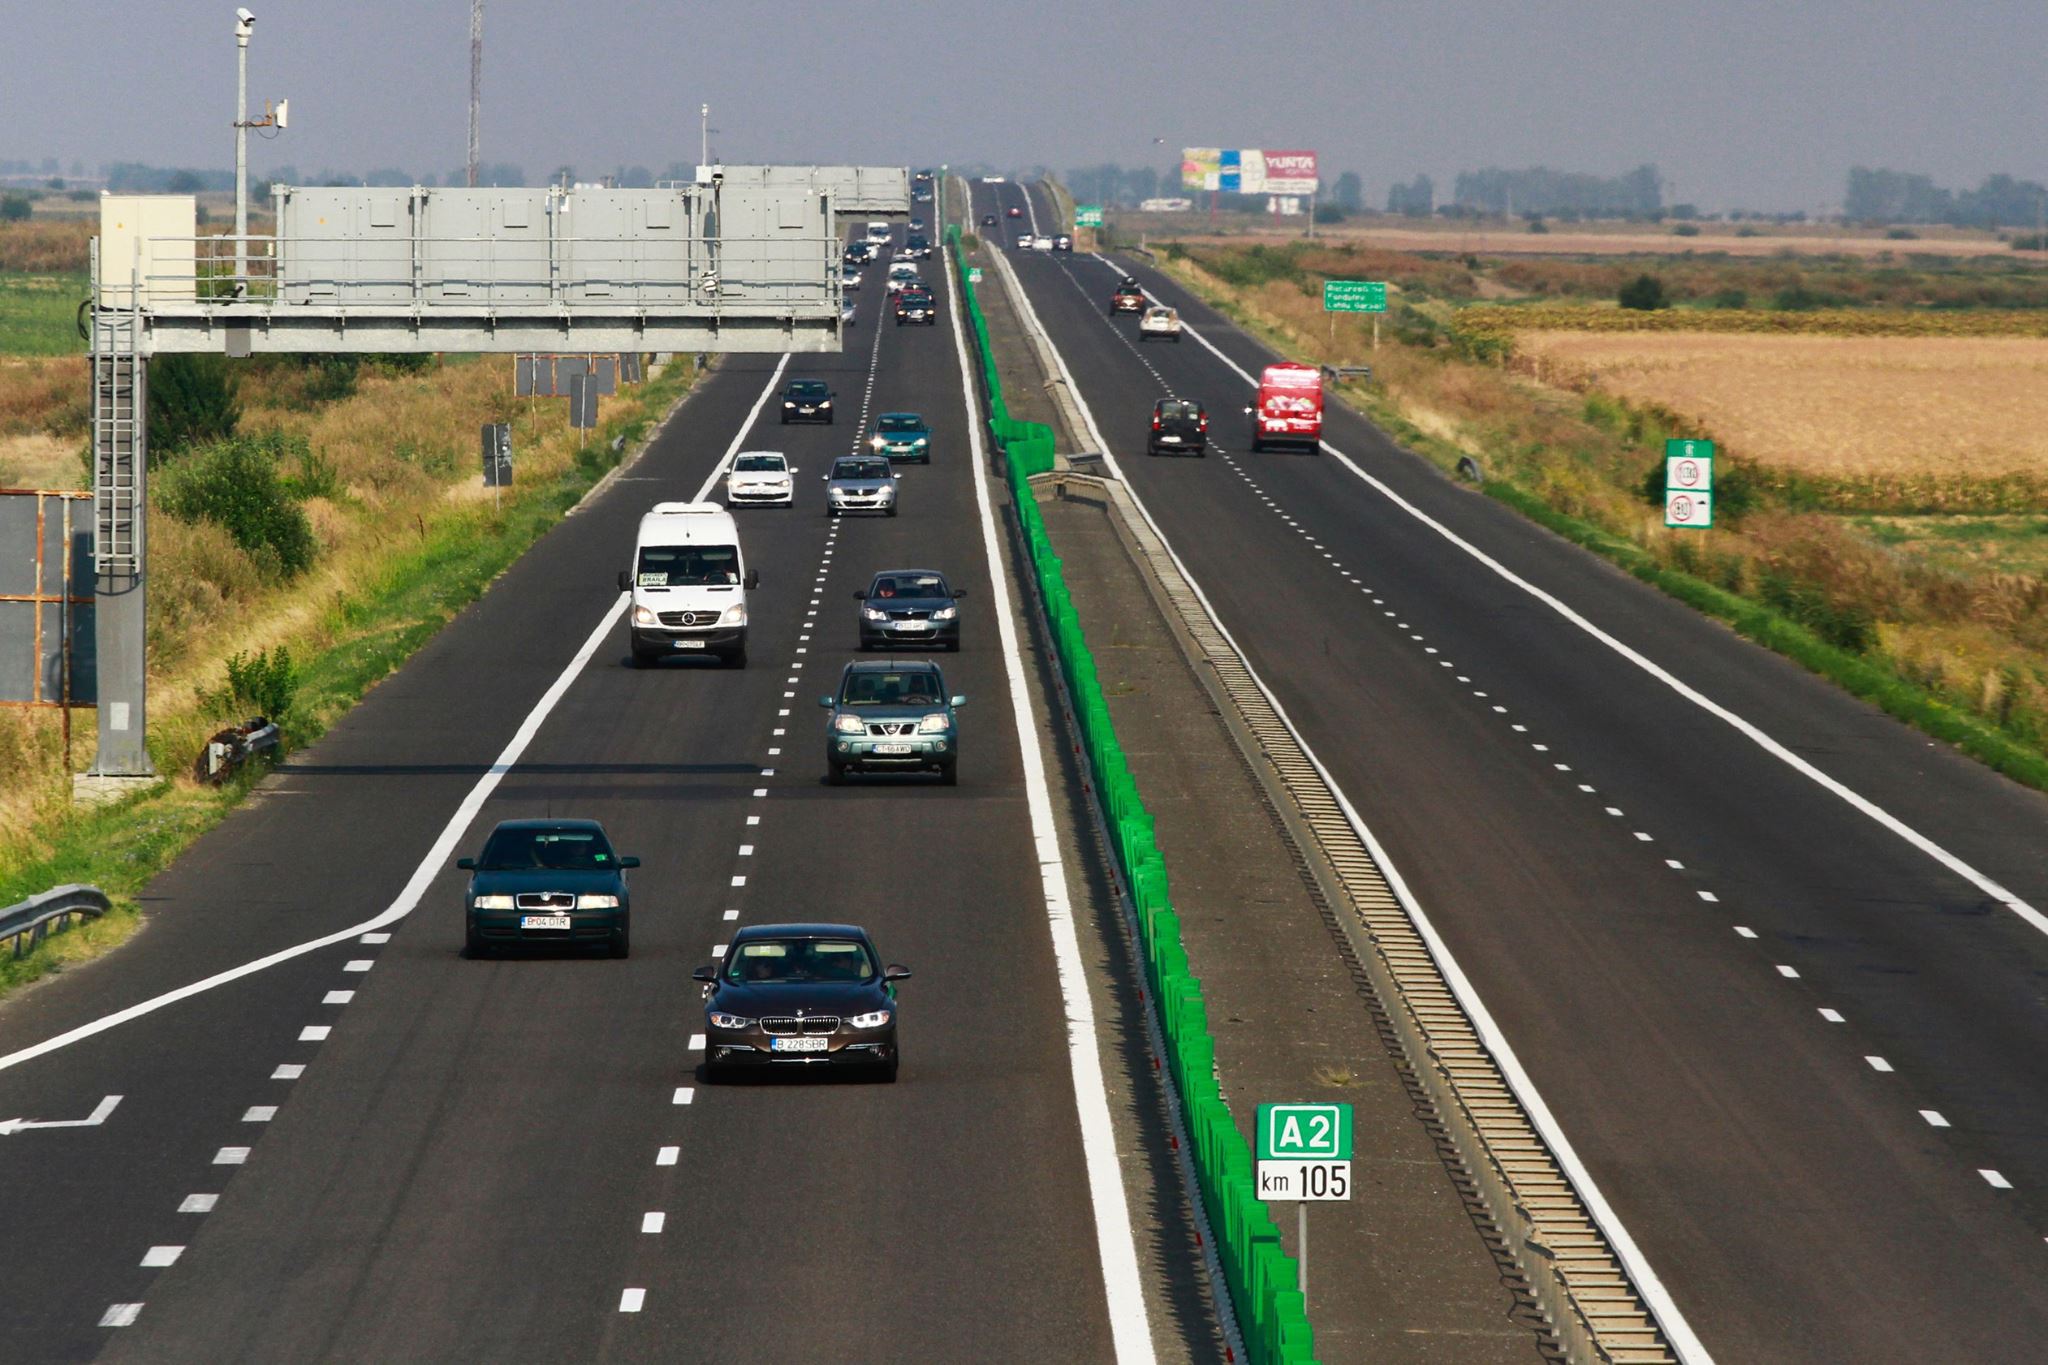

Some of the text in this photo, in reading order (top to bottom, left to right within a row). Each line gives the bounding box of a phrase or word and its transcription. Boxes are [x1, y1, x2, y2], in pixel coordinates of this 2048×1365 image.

[1279, 1115, 1331, 1148] A2
[1262, 1165, 1346, 1198] km 105
